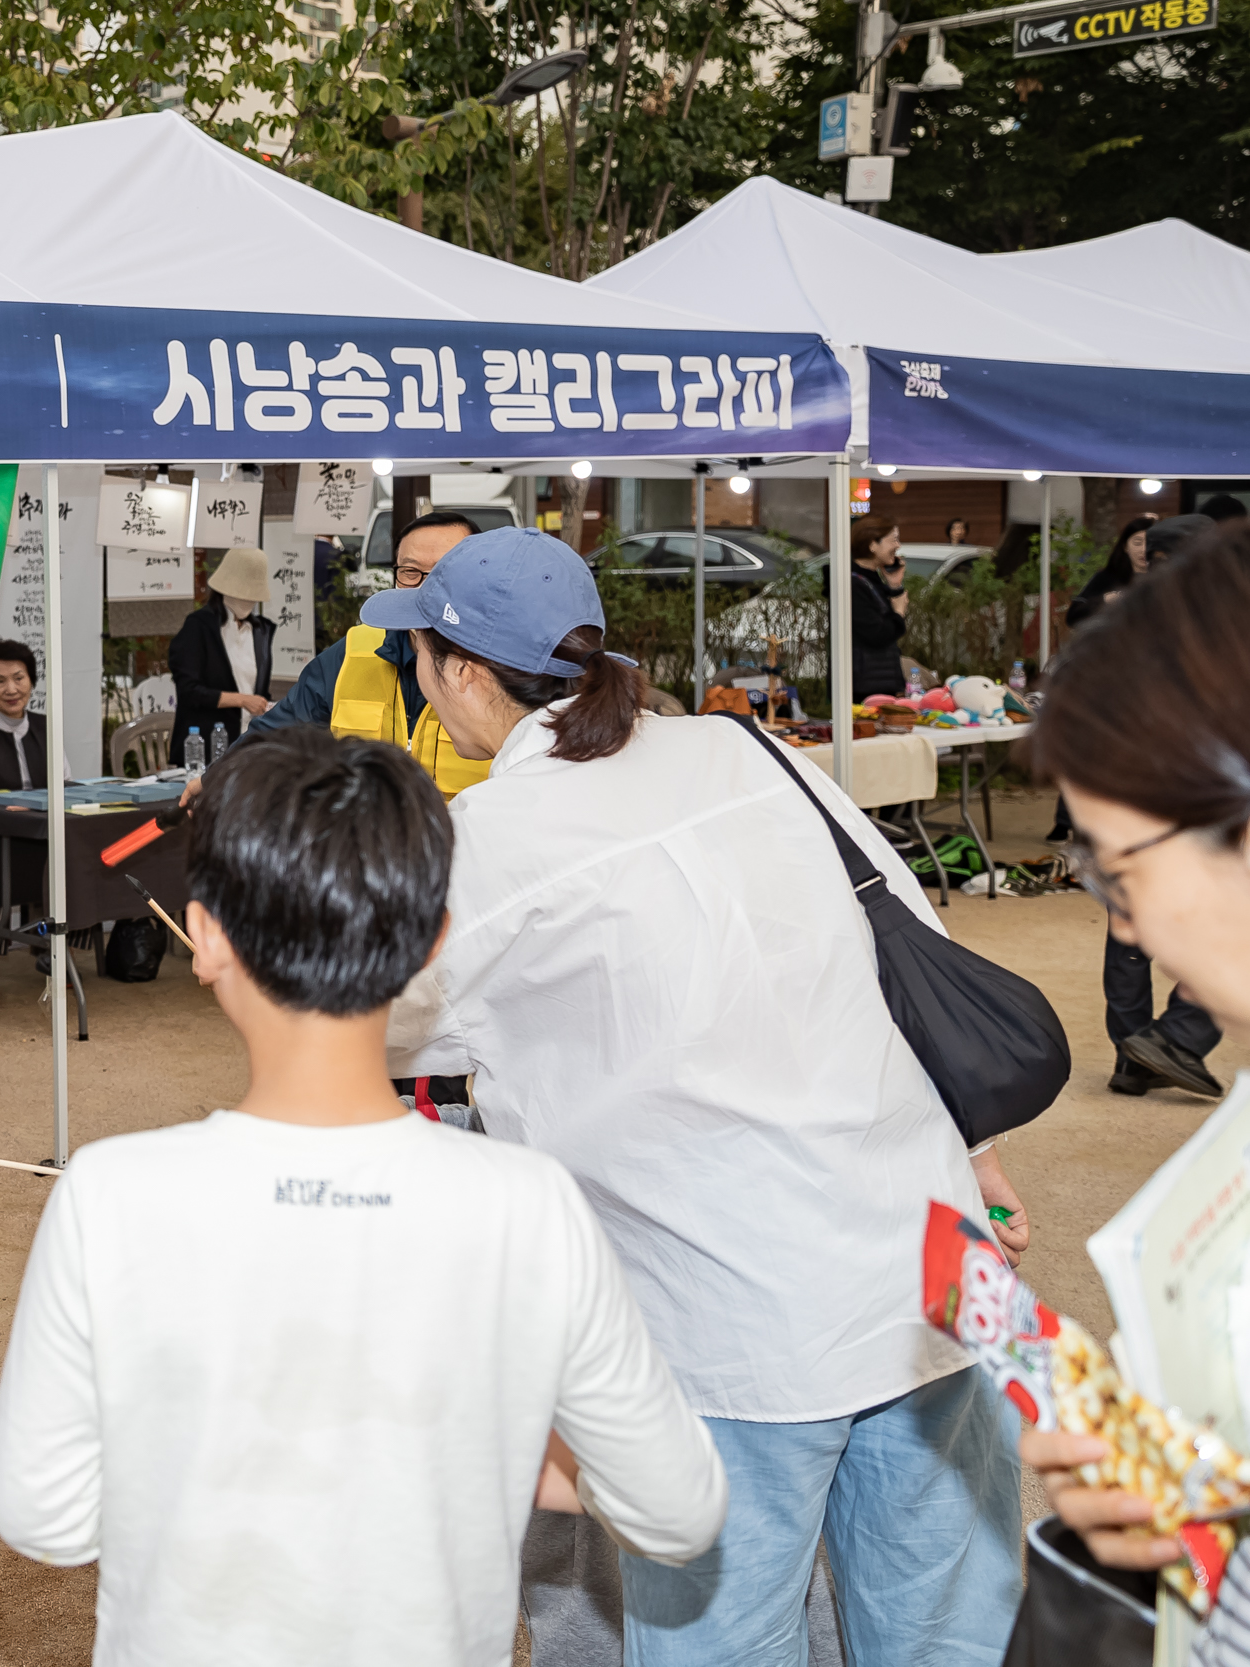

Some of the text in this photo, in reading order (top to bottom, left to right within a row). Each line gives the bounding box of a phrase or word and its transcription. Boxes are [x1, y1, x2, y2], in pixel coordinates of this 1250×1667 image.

[1073, 0, 1210, 40] CCTV 작동중
[153, 337, 467, 432] 시낭송과
[481, 346, 795, 432] 캘리그라피
